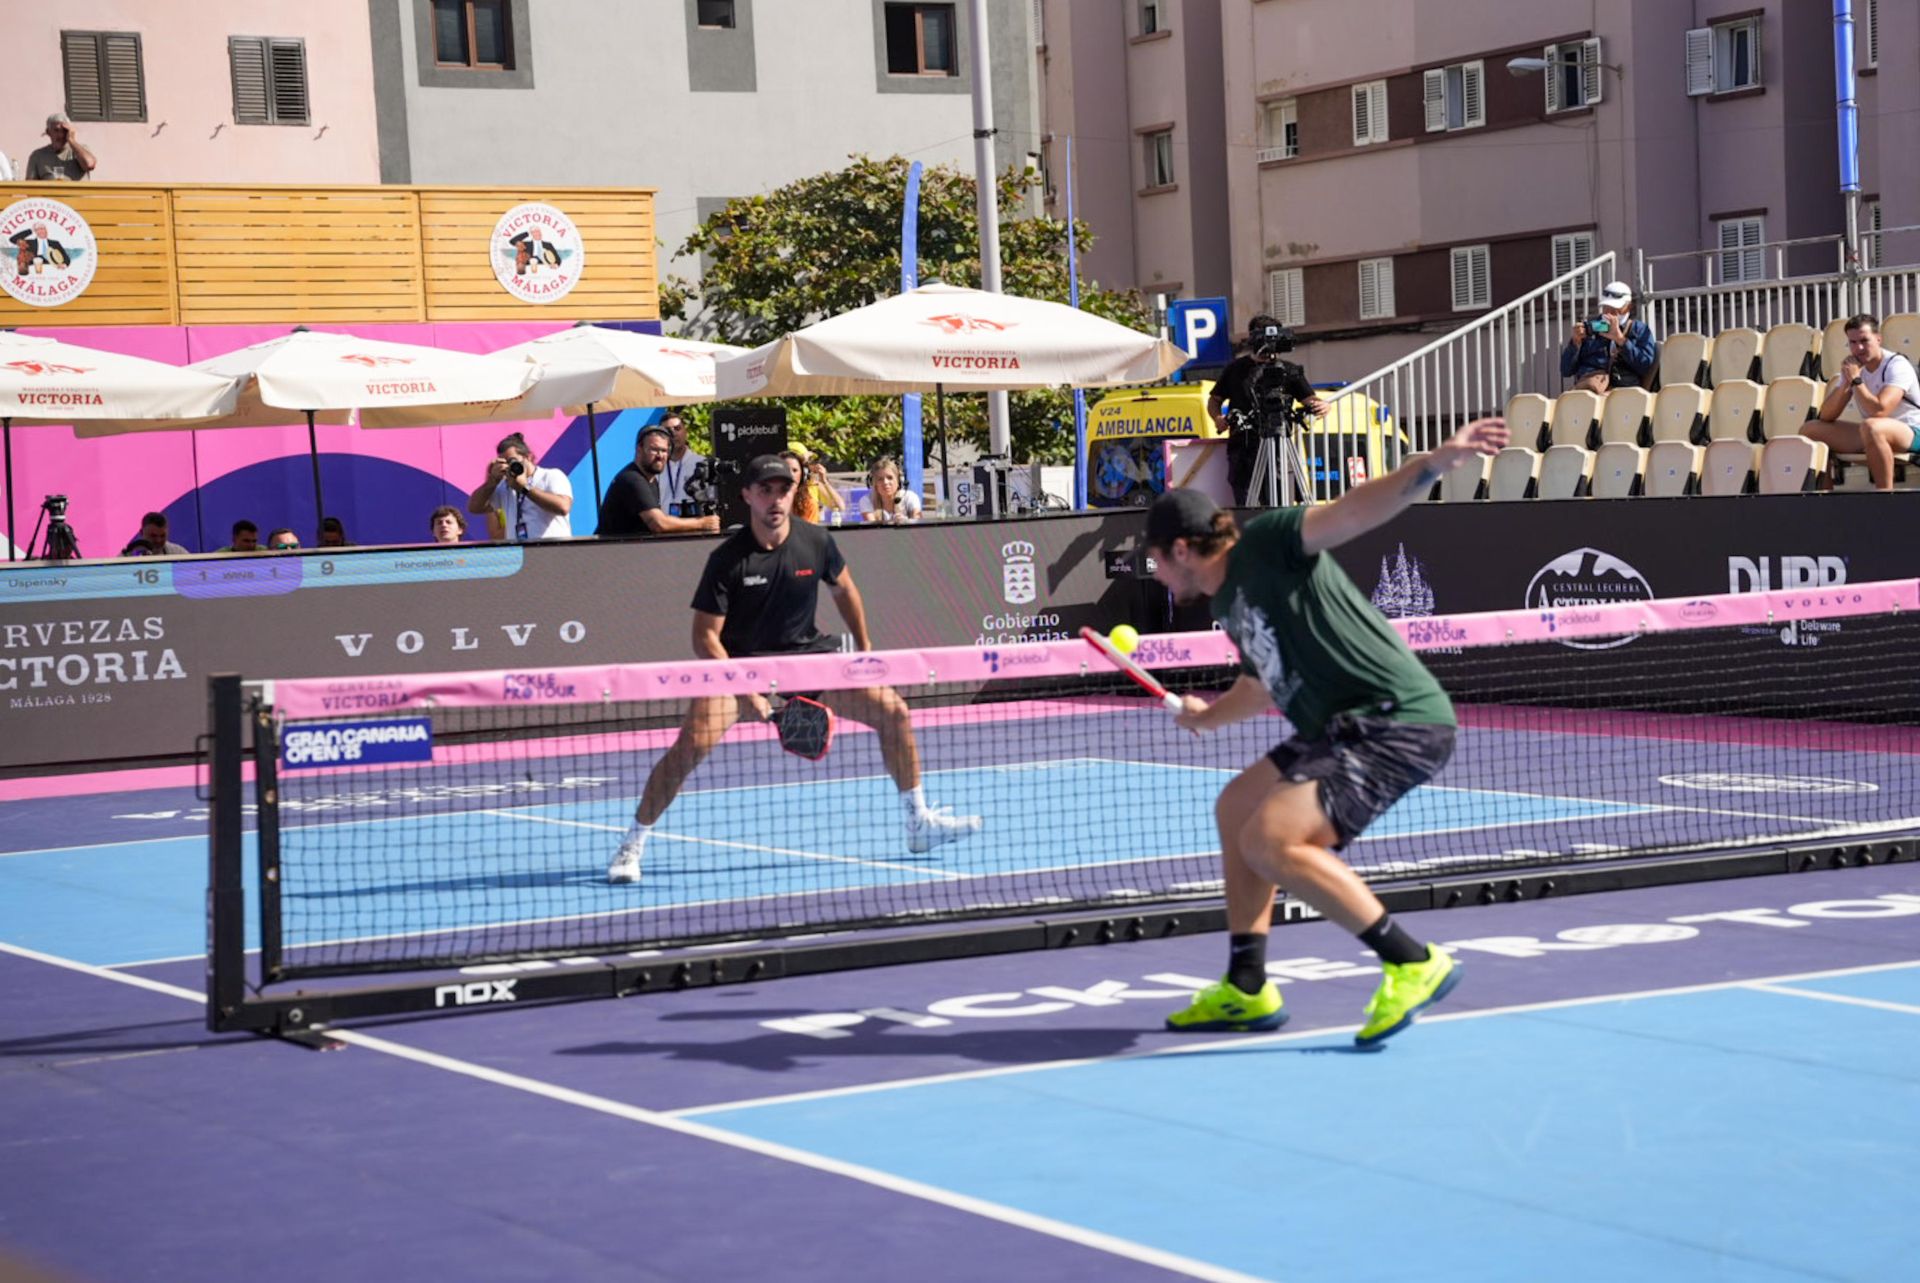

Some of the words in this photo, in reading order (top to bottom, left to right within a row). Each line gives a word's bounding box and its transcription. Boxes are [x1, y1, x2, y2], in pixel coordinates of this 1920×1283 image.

[2, 209, 77, 236] VICTORIA
[502, 213, 567, 238] VICTORIA
[12, 275, 78, 296] MÁLAGA
[511, 274, 568, 294] MÁLAGA
[1185, 308, 1217, 359] P
[932, 356, 1020, 369] VICTORIA
[366, 384, 437, 395] VICTORIA
[17, 393, 103, 405] VICTORIA
[1100, 407, 1122, 416] V24
[737, 424, 778, 438] picklebull
[1096, 416, 1193, 436] AMBULANCIA
[8, 576, 68, 588] Uspensky
[132, 570, 159, 584] 16
[320, 561, 334, 576] 9
[1553, 583, 1594, 592] CENTRAL
[1597, 583, 1640, 593] LECHERA
[1785, 594, 1862, 608] VOLVO
[983, 612, 1060, 630] Gobierno
[1408, 620, 1450, 632] PICKLE
[1558, 613, 1600, 626] picklebull
[1800, 619, 1841, 632] Delaware
[335, 620, 586, 657] VOLVO
[975, 633, 995, 646] de
[997, 629, 1069, 645] Canarias
[1434, 629, 1467, 641] TOUR
[1801, 633, 1818, 646] Life
[1138, 639, 1174, 652] ICKLE
[1157, 650, 1192, 662] TOUR
[657, 671, 758, 684] VOLVO
[328, 680, 402, 693] CERVEZAS
[535, 685, 576, 699] TOUR
[10, 696, 75, 709] MÁLAGA
[81, 693, 112, 704] 1928
[321, 693, 409, 710] VICTORIA
[342, 725, 428, 744] CANARIA
[286, 744, 341, 763] OPEN
